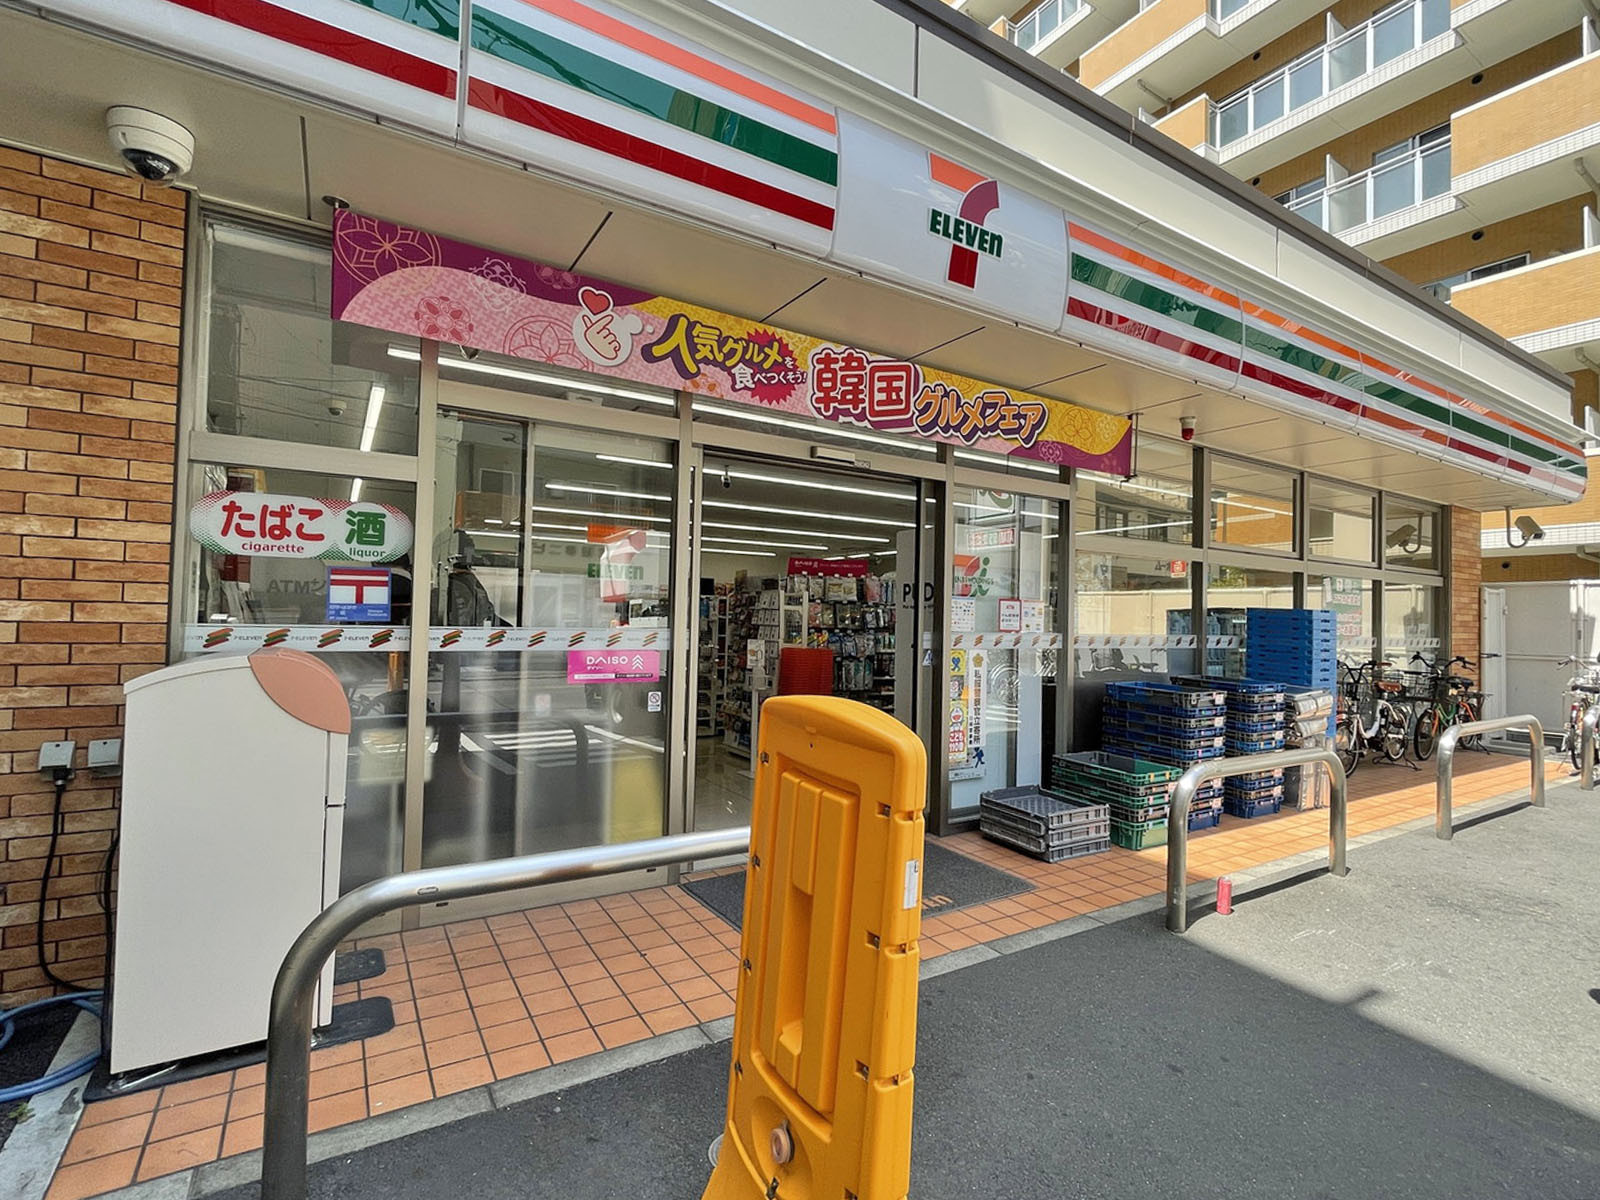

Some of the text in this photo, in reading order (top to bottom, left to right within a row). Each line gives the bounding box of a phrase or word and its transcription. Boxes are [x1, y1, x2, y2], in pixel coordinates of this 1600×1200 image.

[220, 500, 326, 541] たばこ
[344, 509, 387, 547] 酒
[241, 541, 305, 554] cigarette
[350, 547, 387, 559] liquor
[586, 656, 628, 664] DAISO
